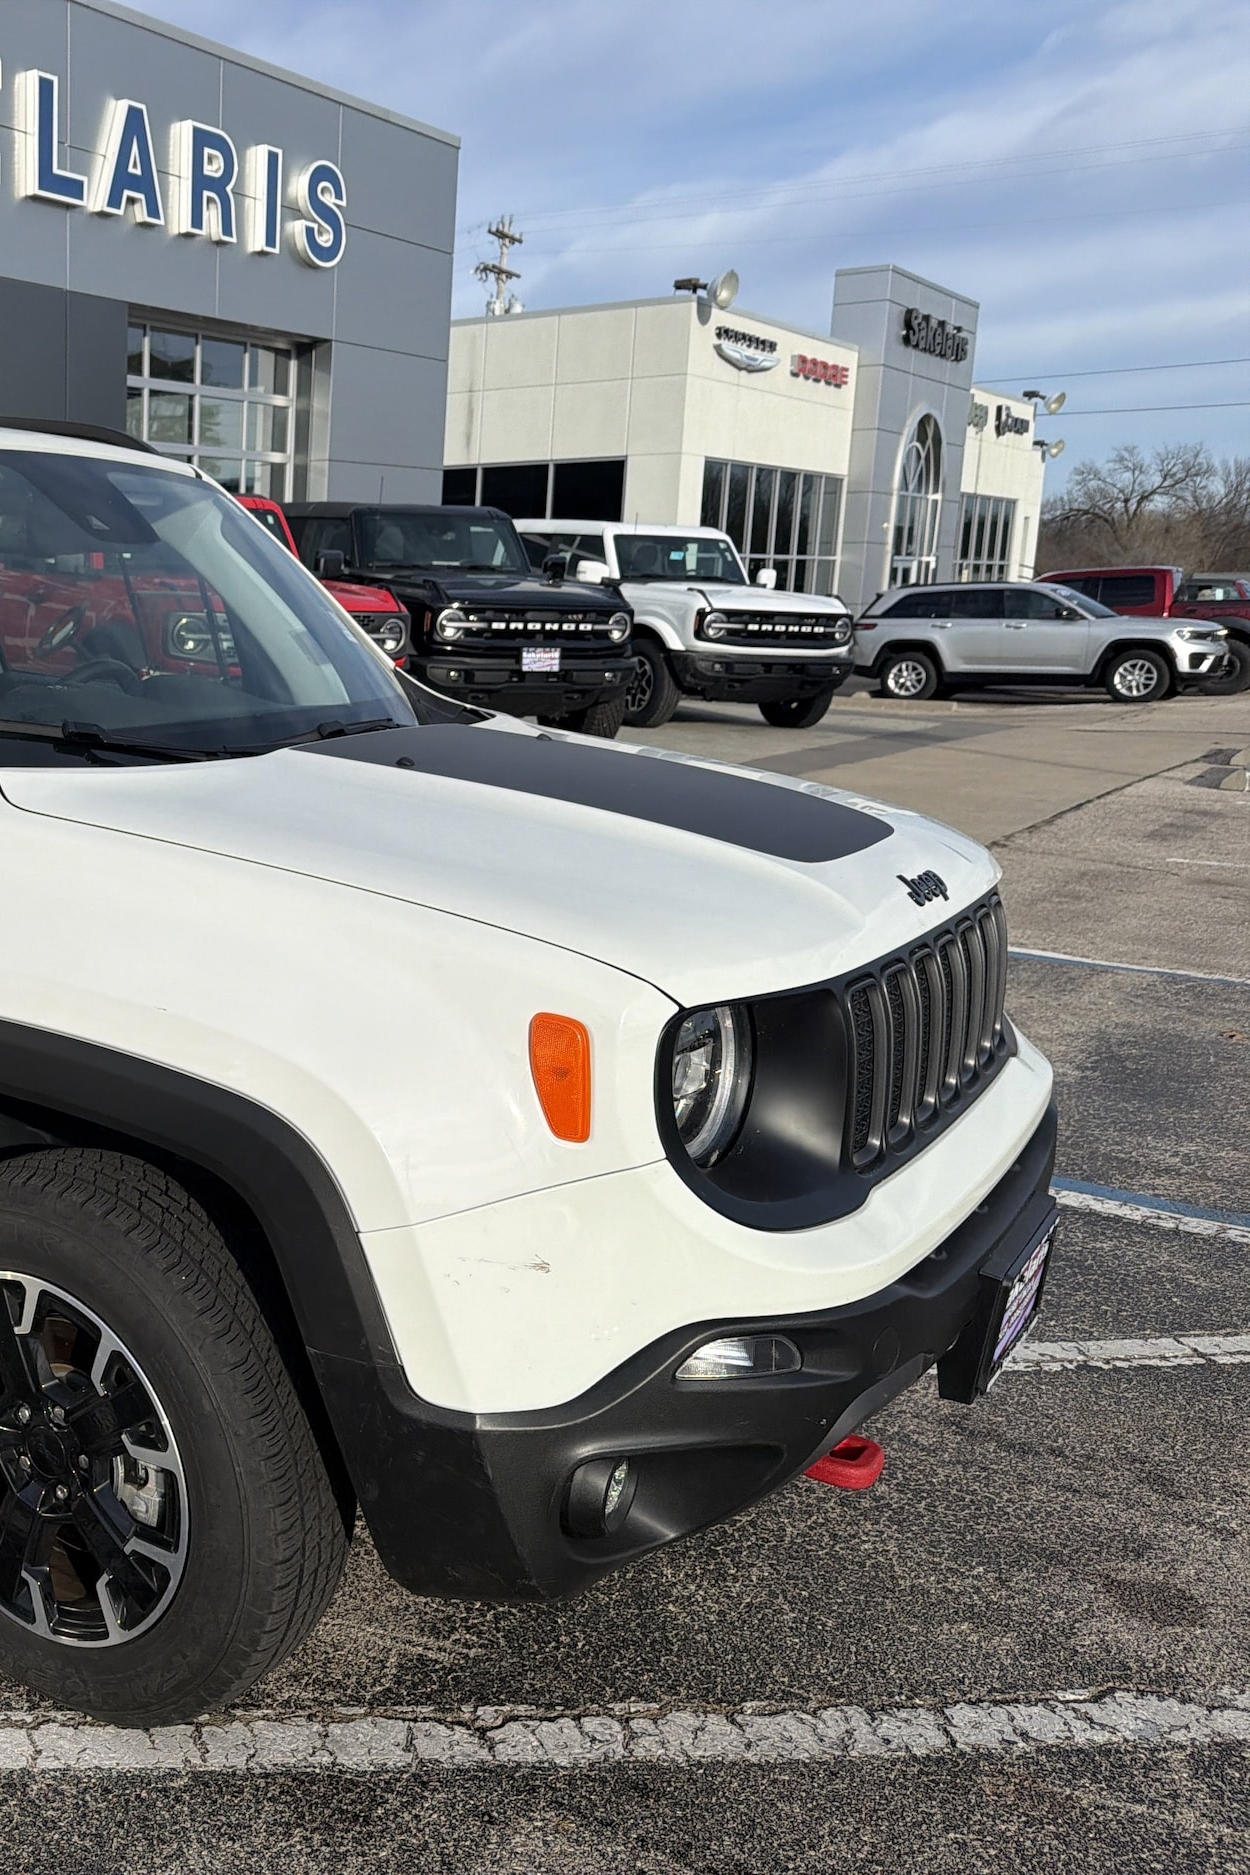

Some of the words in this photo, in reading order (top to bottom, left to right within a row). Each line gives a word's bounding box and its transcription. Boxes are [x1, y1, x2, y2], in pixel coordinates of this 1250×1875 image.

[903, 308, 969, 362] Sakelaris
[797, 354, 850, 386] DODGE
[491, 622, 593, 631] BRONCO
[747, 623, 825, 633] BRONCO
[896, 870, 949, 907] Jeep
